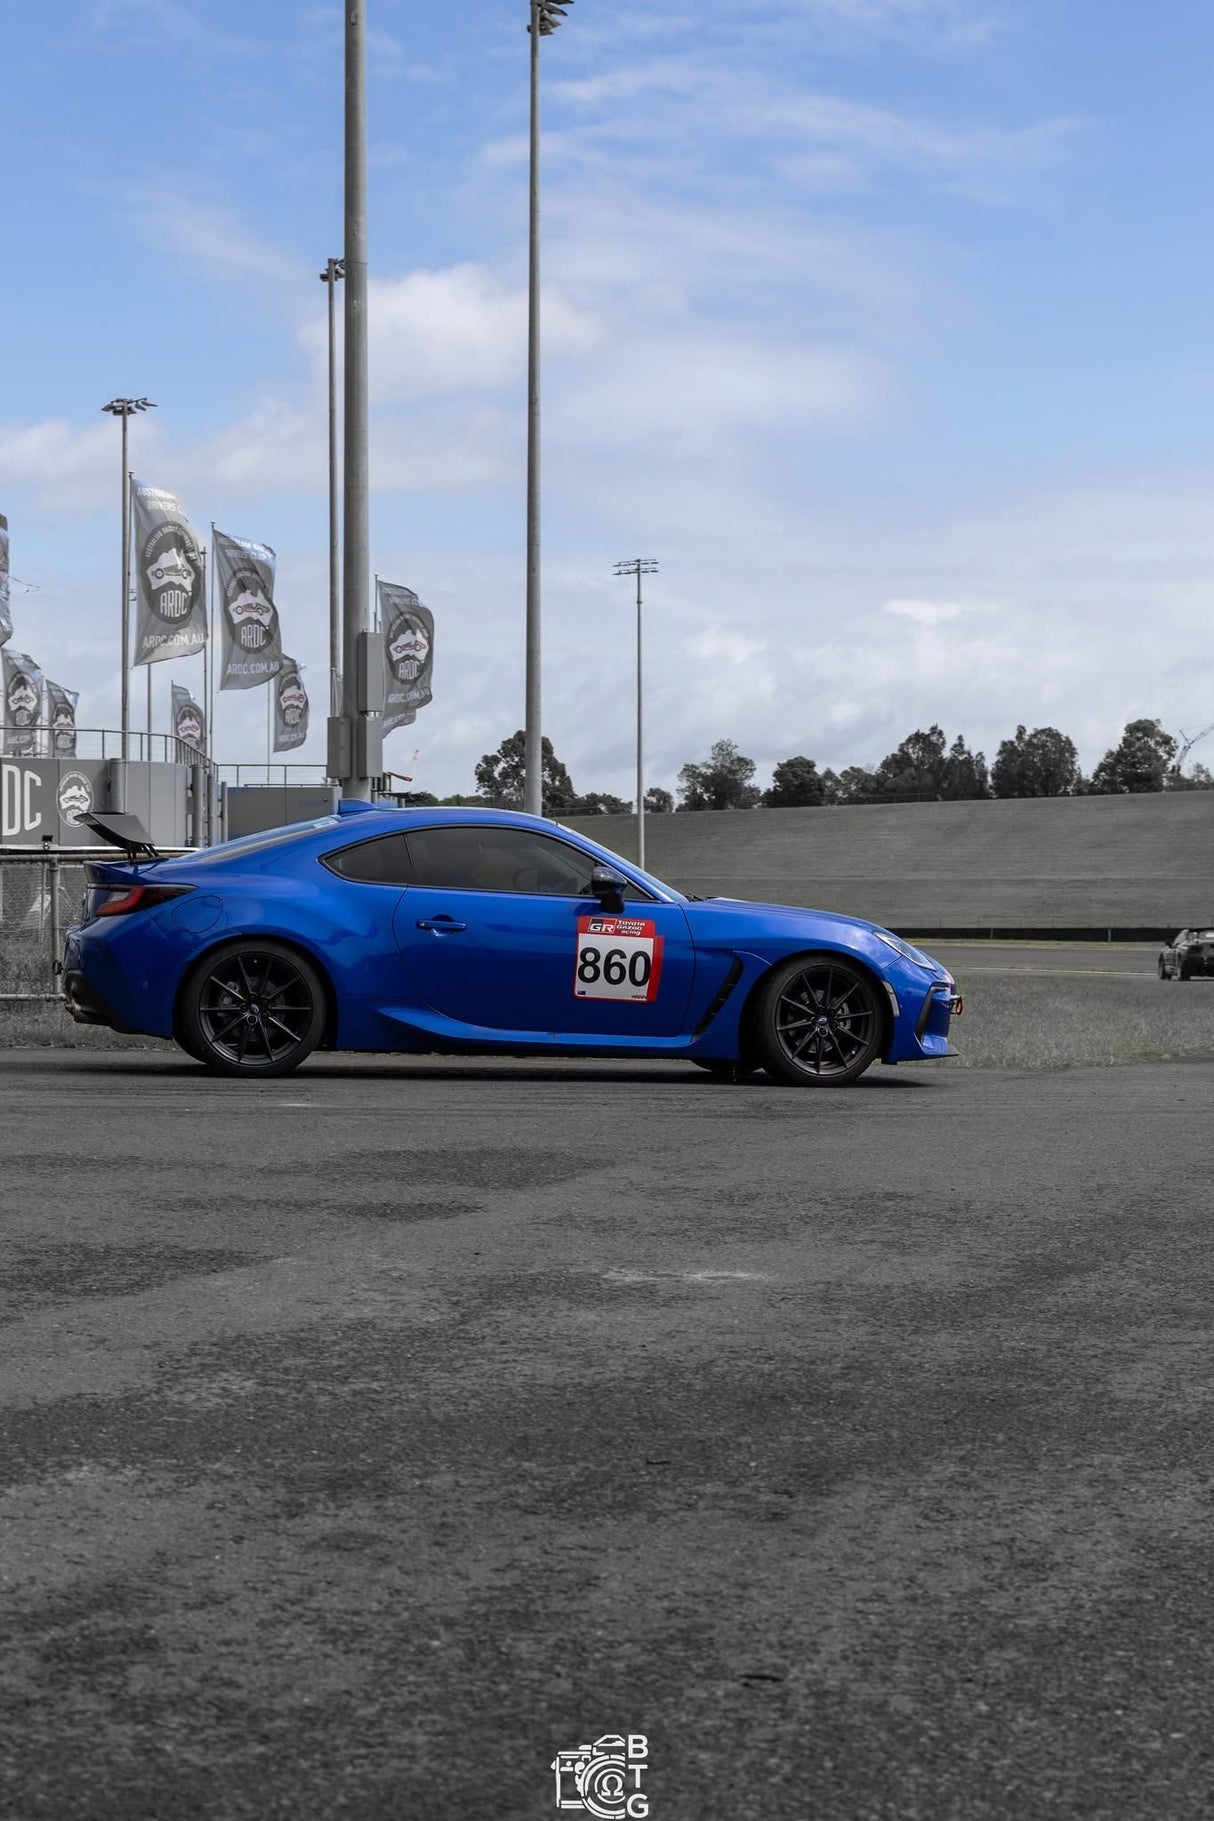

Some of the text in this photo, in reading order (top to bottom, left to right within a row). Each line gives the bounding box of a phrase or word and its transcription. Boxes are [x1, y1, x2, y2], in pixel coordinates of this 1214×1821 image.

[160, 590, 188, 618] ARDC
[143, 632, 204, 649] ARDC.COM.AU
[241, 624, 266, 649] ARDC
[226, 661, 280, 675] ARDC.COM.AU
[399, 659, 420, 680] ARDC
[589, 923, 614, 933] GR
[578, 947, 651, 987] 860
